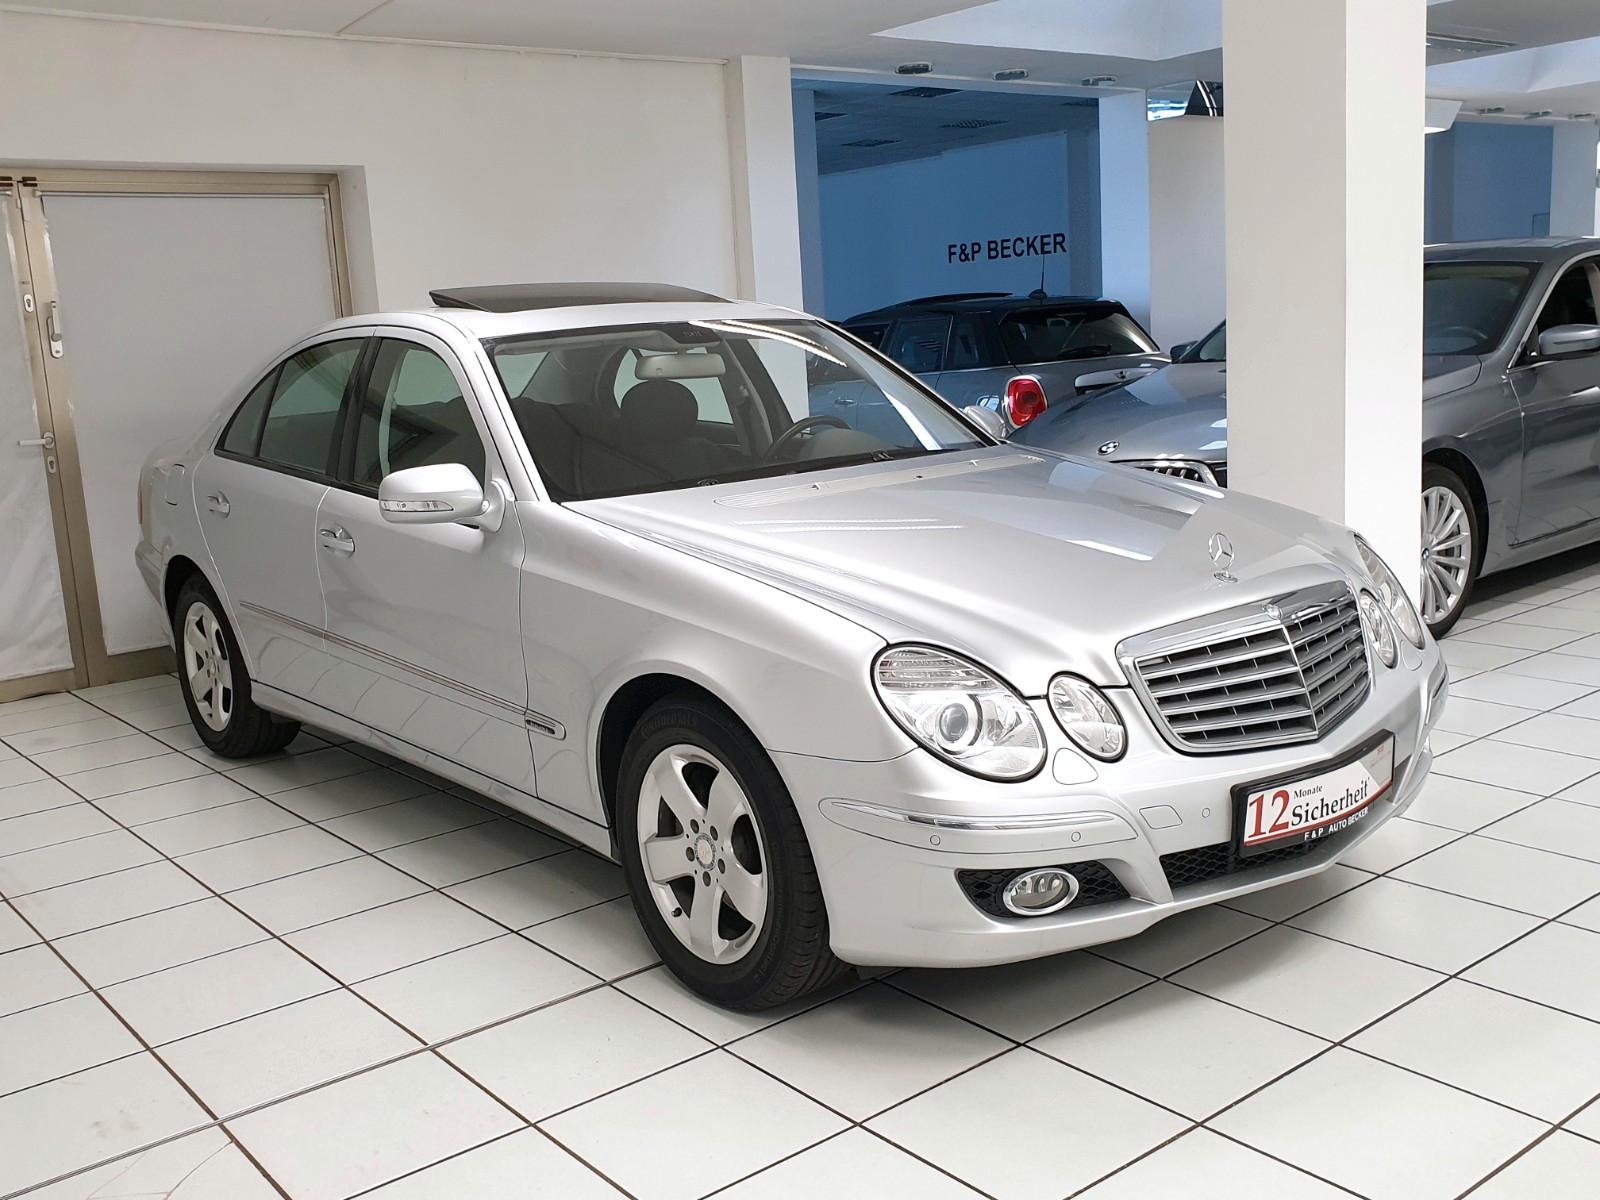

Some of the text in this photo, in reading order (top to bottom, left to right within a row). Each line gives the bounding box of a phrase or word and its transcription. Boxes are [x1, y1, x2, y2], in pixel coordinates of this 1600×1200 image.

[948, 233, 1066, 264] F&P BECKER
[1248, 785, 1323, 838] 12 Monate
[1291, 777, 1369, 826] Sicherheit
[1328, 819, 1347, 834] AUTO
[1347, 807, 1369, 826] BECKER
